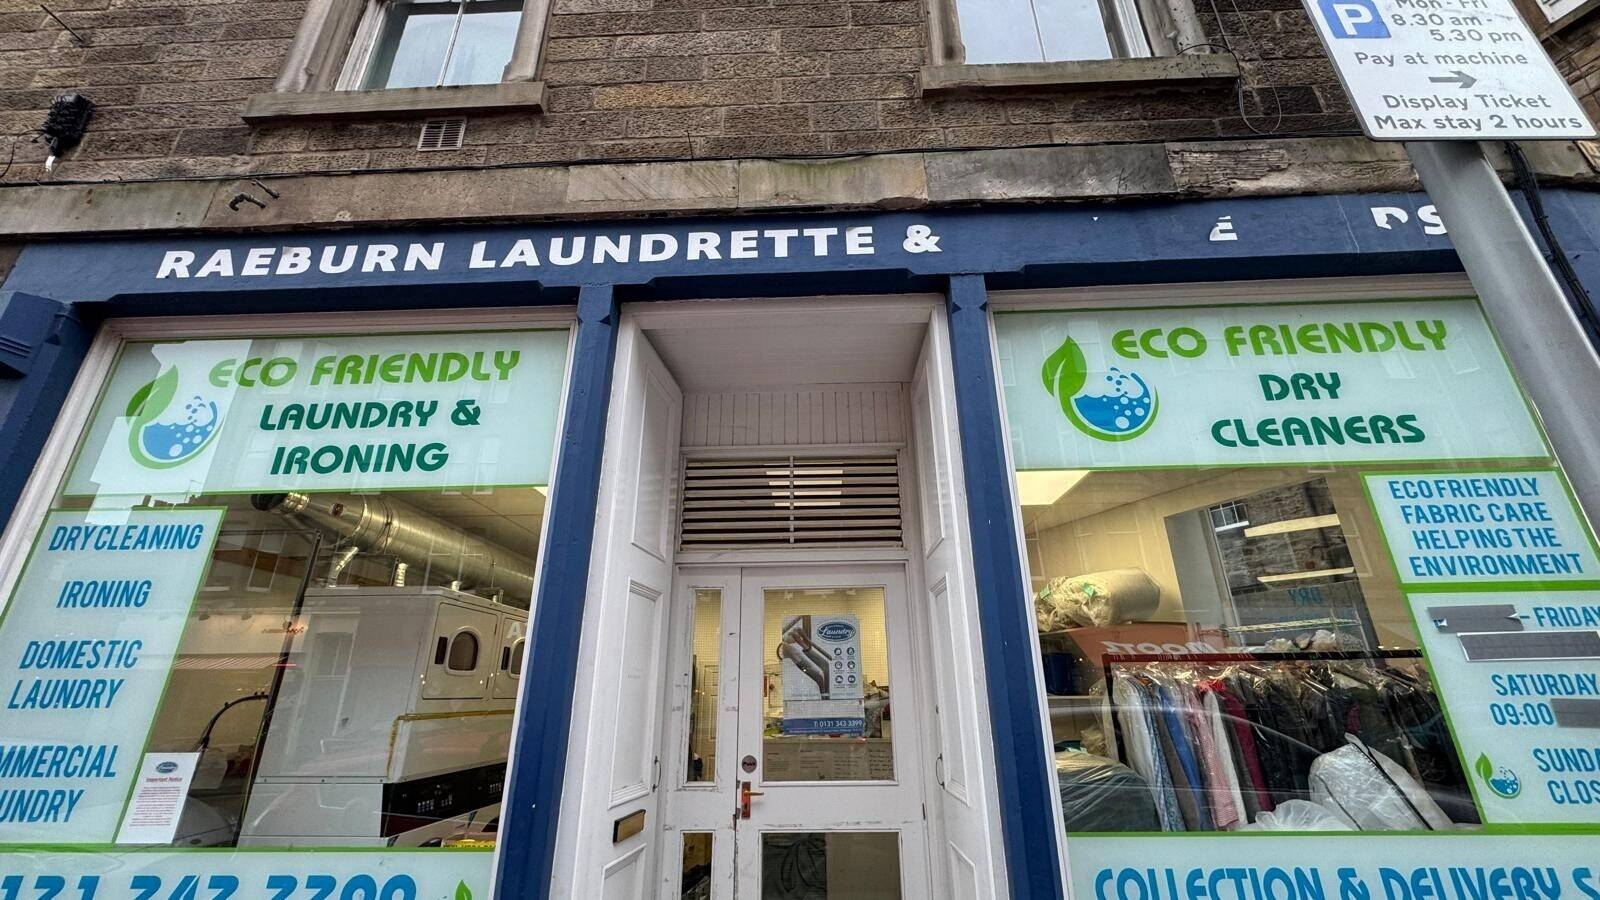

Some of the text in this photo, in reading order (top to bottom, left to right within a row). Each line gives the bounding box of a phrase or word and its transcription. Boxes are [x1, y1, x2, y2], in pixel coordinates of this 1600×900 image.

[1334, 3, 1373, 36] P
[1391, 14, 1444, 27] 8.30
[1449, 16, 1482, 26] am
[1429, 29, 1523, 44] 5.30 pm
[1354, 51, 1529, 67] Pay at machine
[1383, 94, 1552, 110] Display Ticket
[1373, 114, 1583, 131] Max stay 2 hours
[156, 242, 445, 279] RAEBURN
[468, 226, 876, 269] LAUNDRETTE
[902, 224, 942, 254] &
[1111, 319, 1447, 359] ECO FRIENDLY
[208, 350, 521, 388] ECO FRIENDLY
[1258, 372, 1341, 401] DRY
[259, 399, 481, 431] LAUNDRY &
[1211, 414, 1425, 447] CLEANERS
[269, 443, 449, 475] IRONING
[1388, 477, 1541, 500] ECO FRIENDLY
[1400, 502, 1553, 524] FABRIC CARE
[48, 524, 204, 551] DRY CLEANING
[1412, 527, 1562, 550] HELPING THE
[1409, 553, 1584, 577] ENVIRONMENT
[56, 580, 153, 608] IRONING
[19, 639, 143, 669] DOMESTIC
[8, 679, 125, 709] LAUNDRY
[1491, 673, 1600, 696] SATURDAY
[1490, 702, 1554, 725] 09:00
[0, 789, 84, 823] UNDRY
[1094, 867, 1323, 900] COLLECTION
[1378, 867, 1561, 900] DELIVERY
